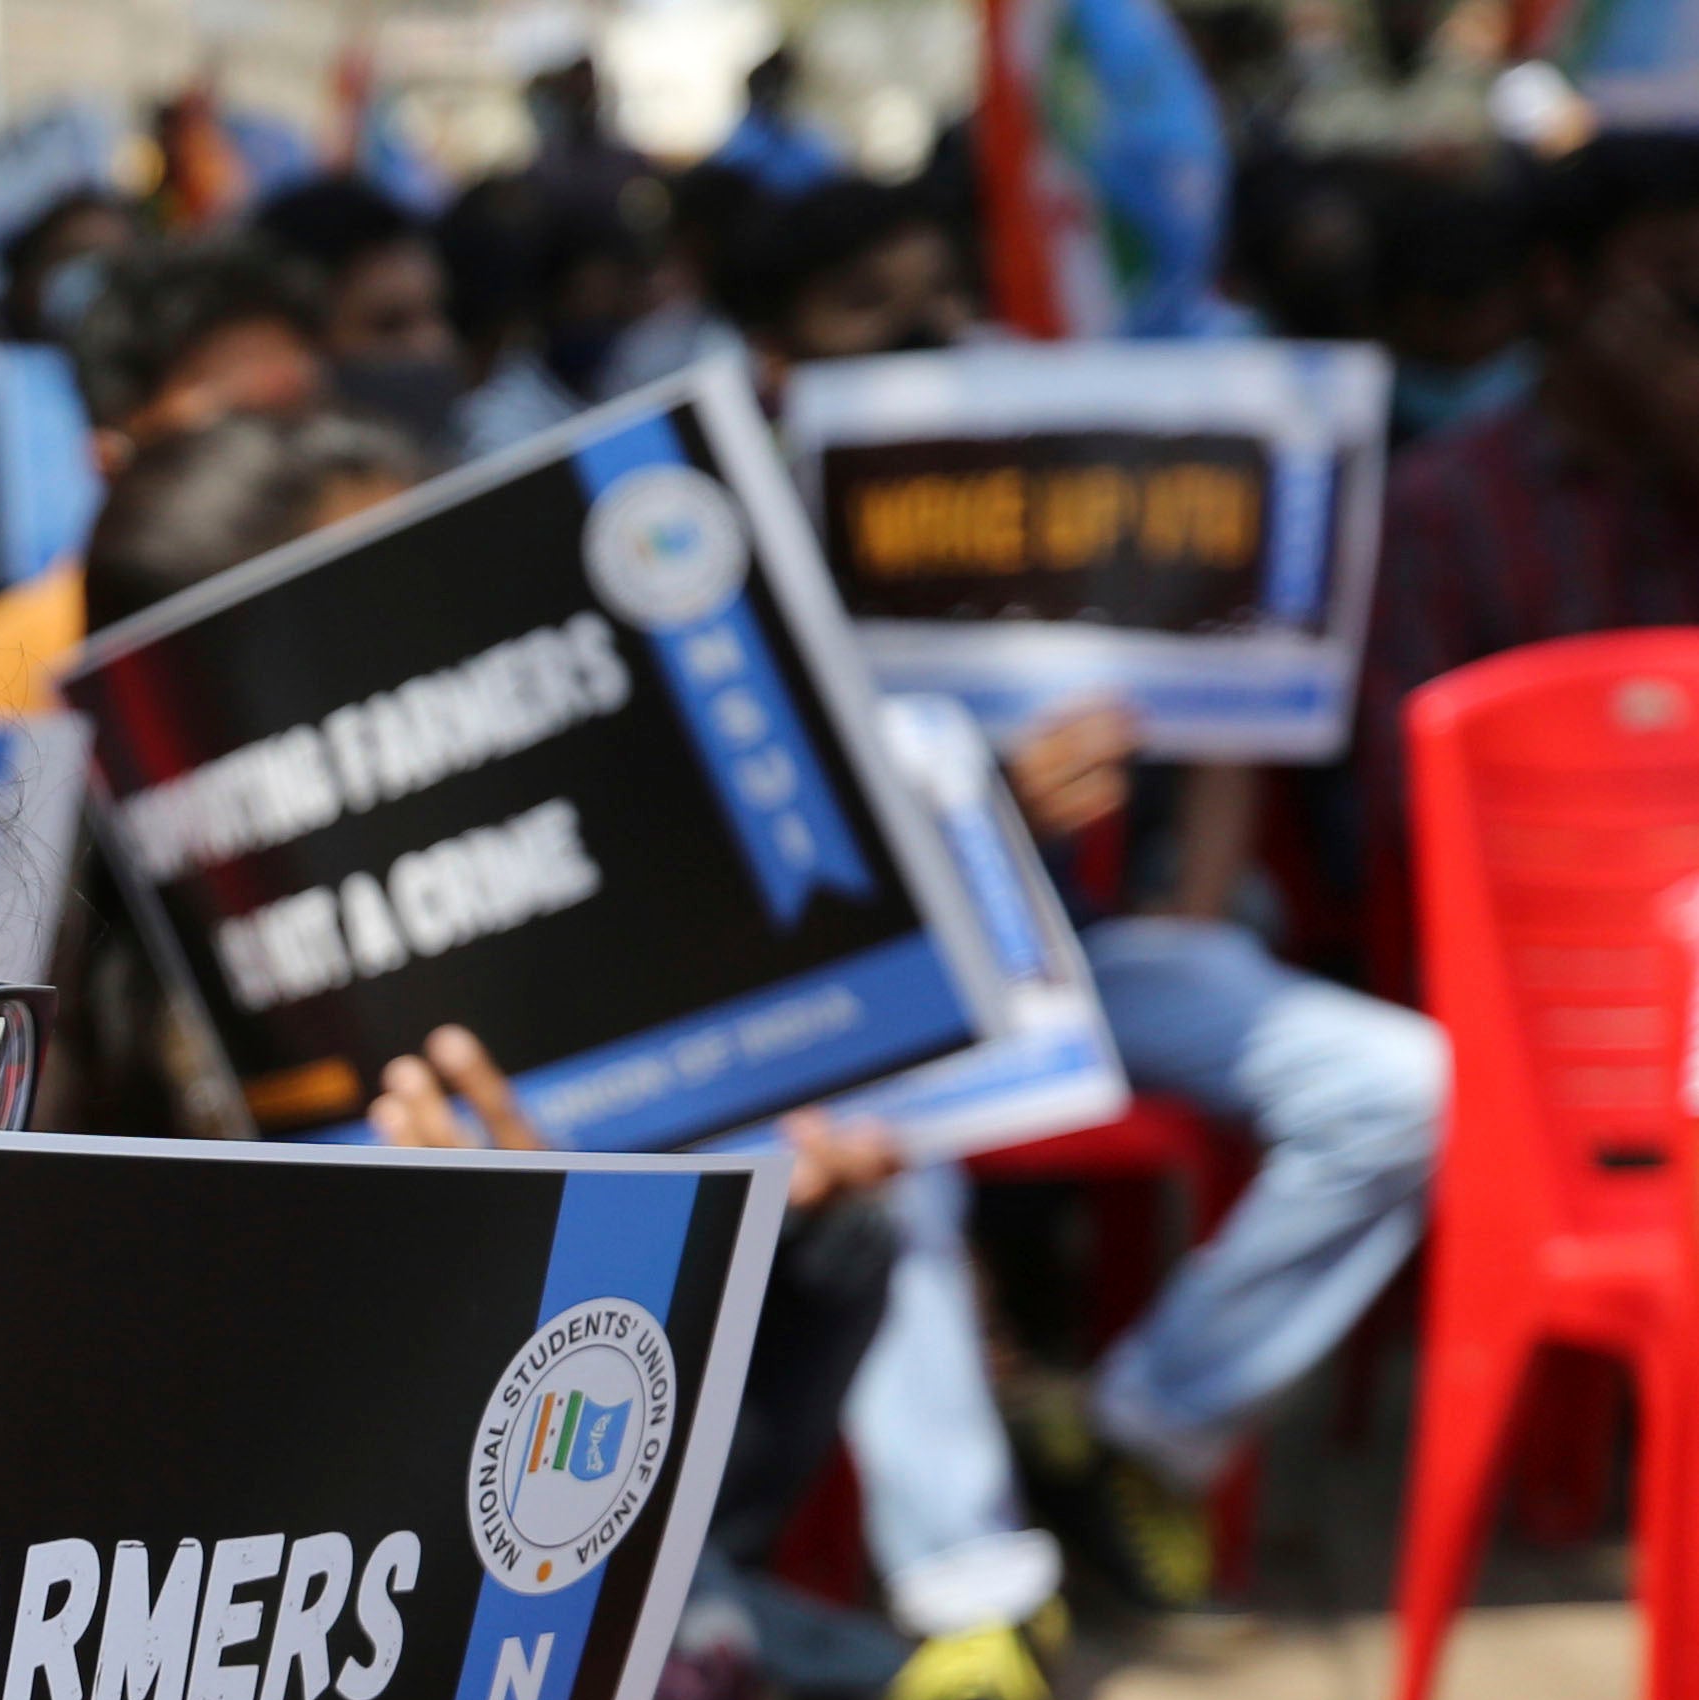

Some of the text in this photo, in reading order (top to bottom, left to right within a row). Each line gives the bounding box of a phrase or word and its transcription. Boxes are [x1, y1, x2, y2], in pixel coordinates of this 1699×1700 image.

[320, 609, 633, 814] FARMERS
[386, 796, 603, 959] CRIME
[636, 1328, 670, 1427] UNION
[478, 1418, 523, 1572] NATIONAL
[640, 1437, 661, 1486] OF
[575, 1489, 638, 1566] INDIA
